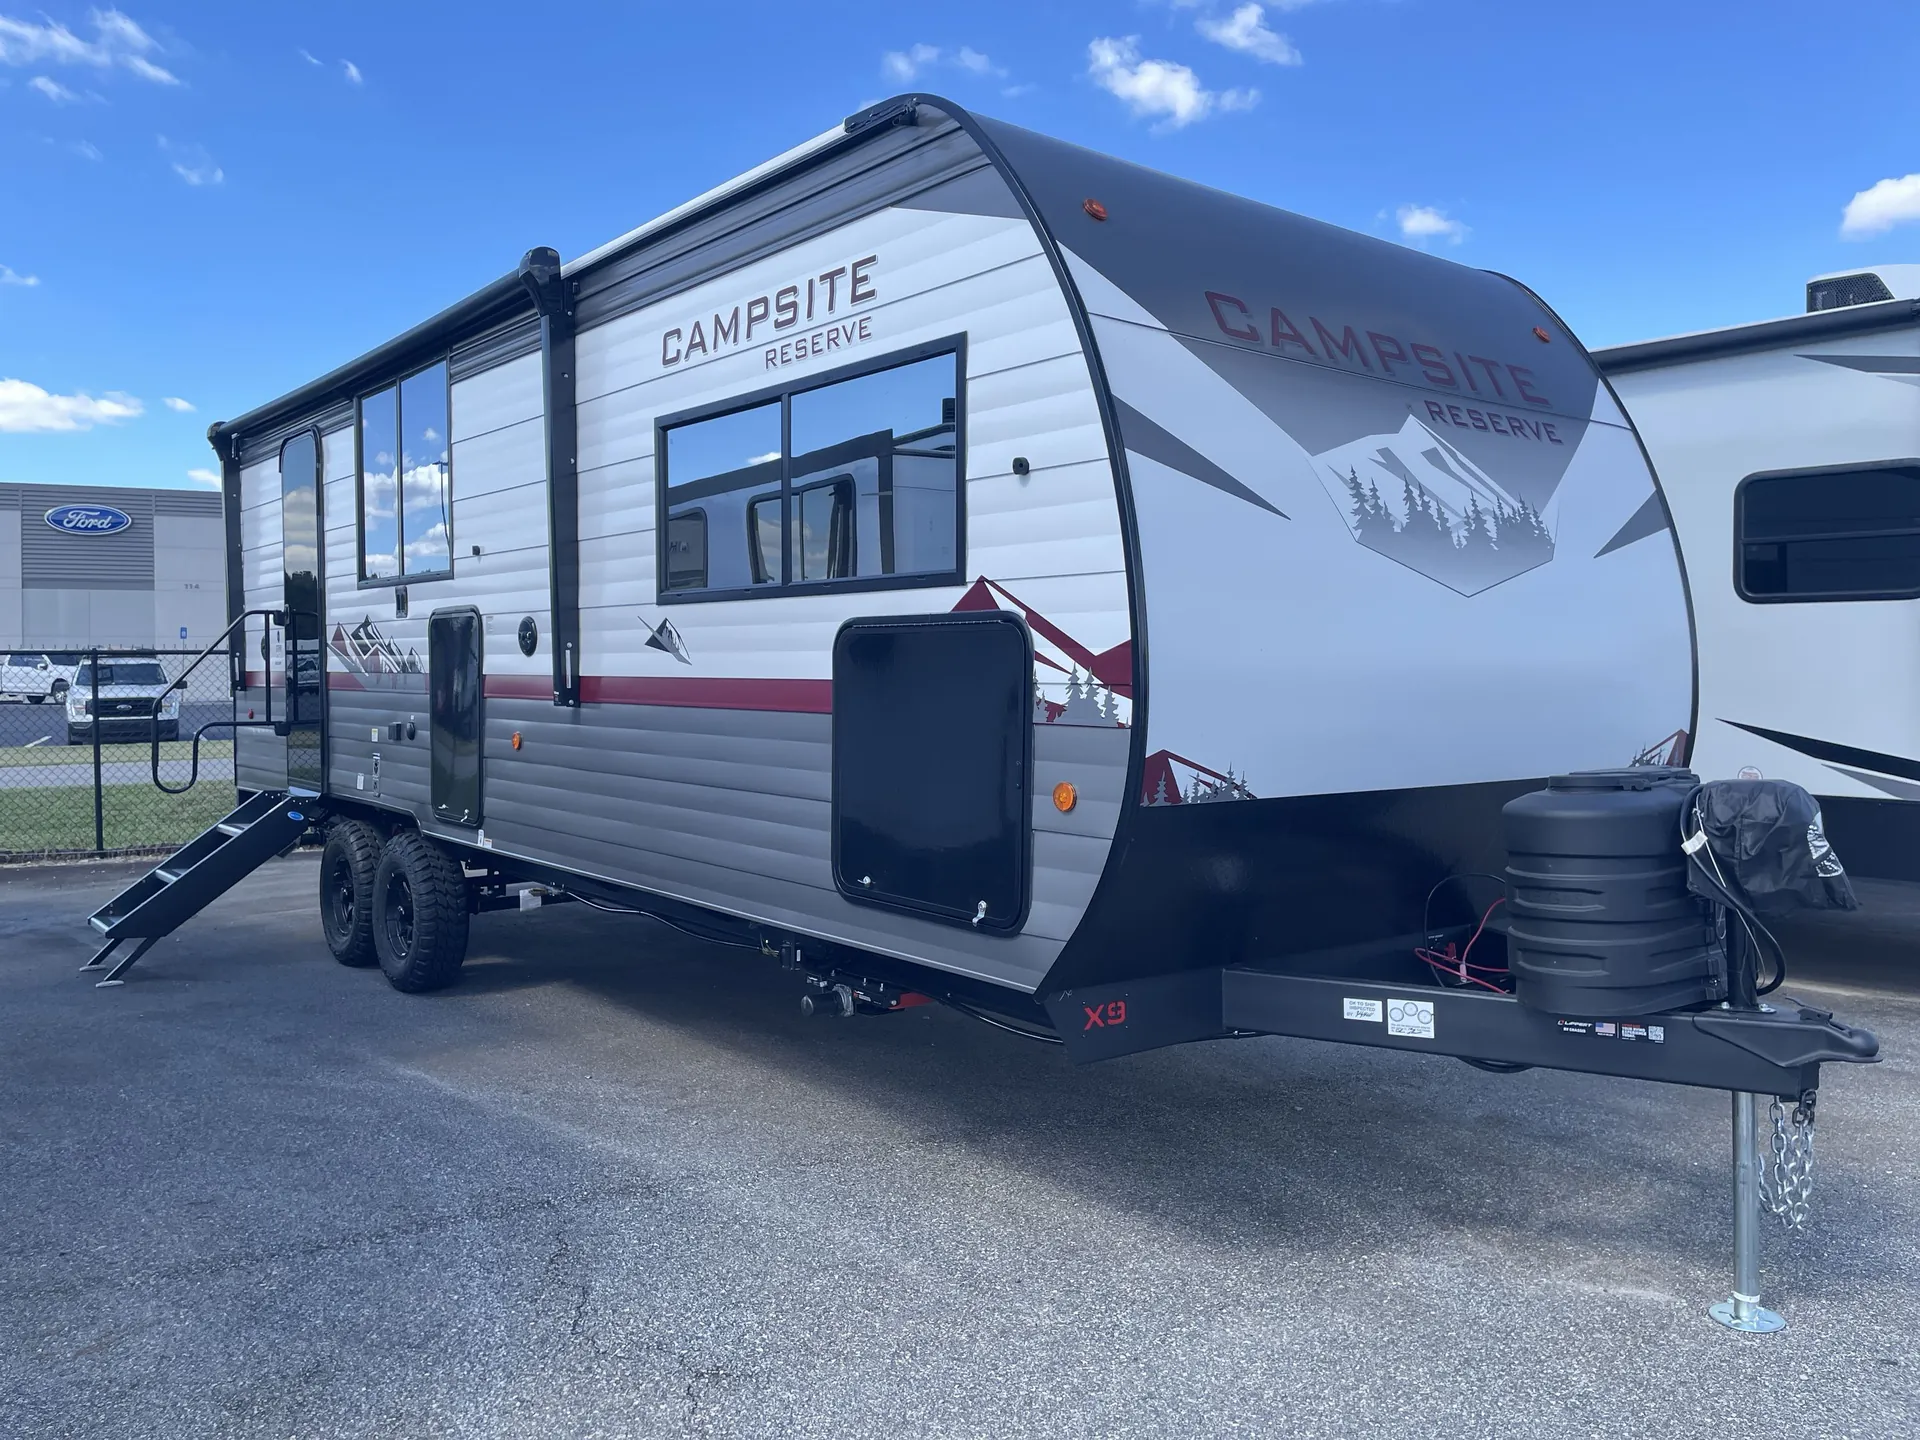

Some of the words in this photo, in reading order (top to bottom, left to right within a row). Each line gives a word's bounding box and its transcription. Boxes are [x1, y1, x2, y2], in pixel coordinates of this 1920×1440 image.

[662, 254, 878, 366] CAMPSITE
[765, 316, 872, 370] RESERVE
[1204, 290, 1551, 406] CAMPSITE
[1424, 400, 1563, 445] RESERVE
[62, 510, 112, 530] Ford
[1084, 1001, 1126, 1030] X9
